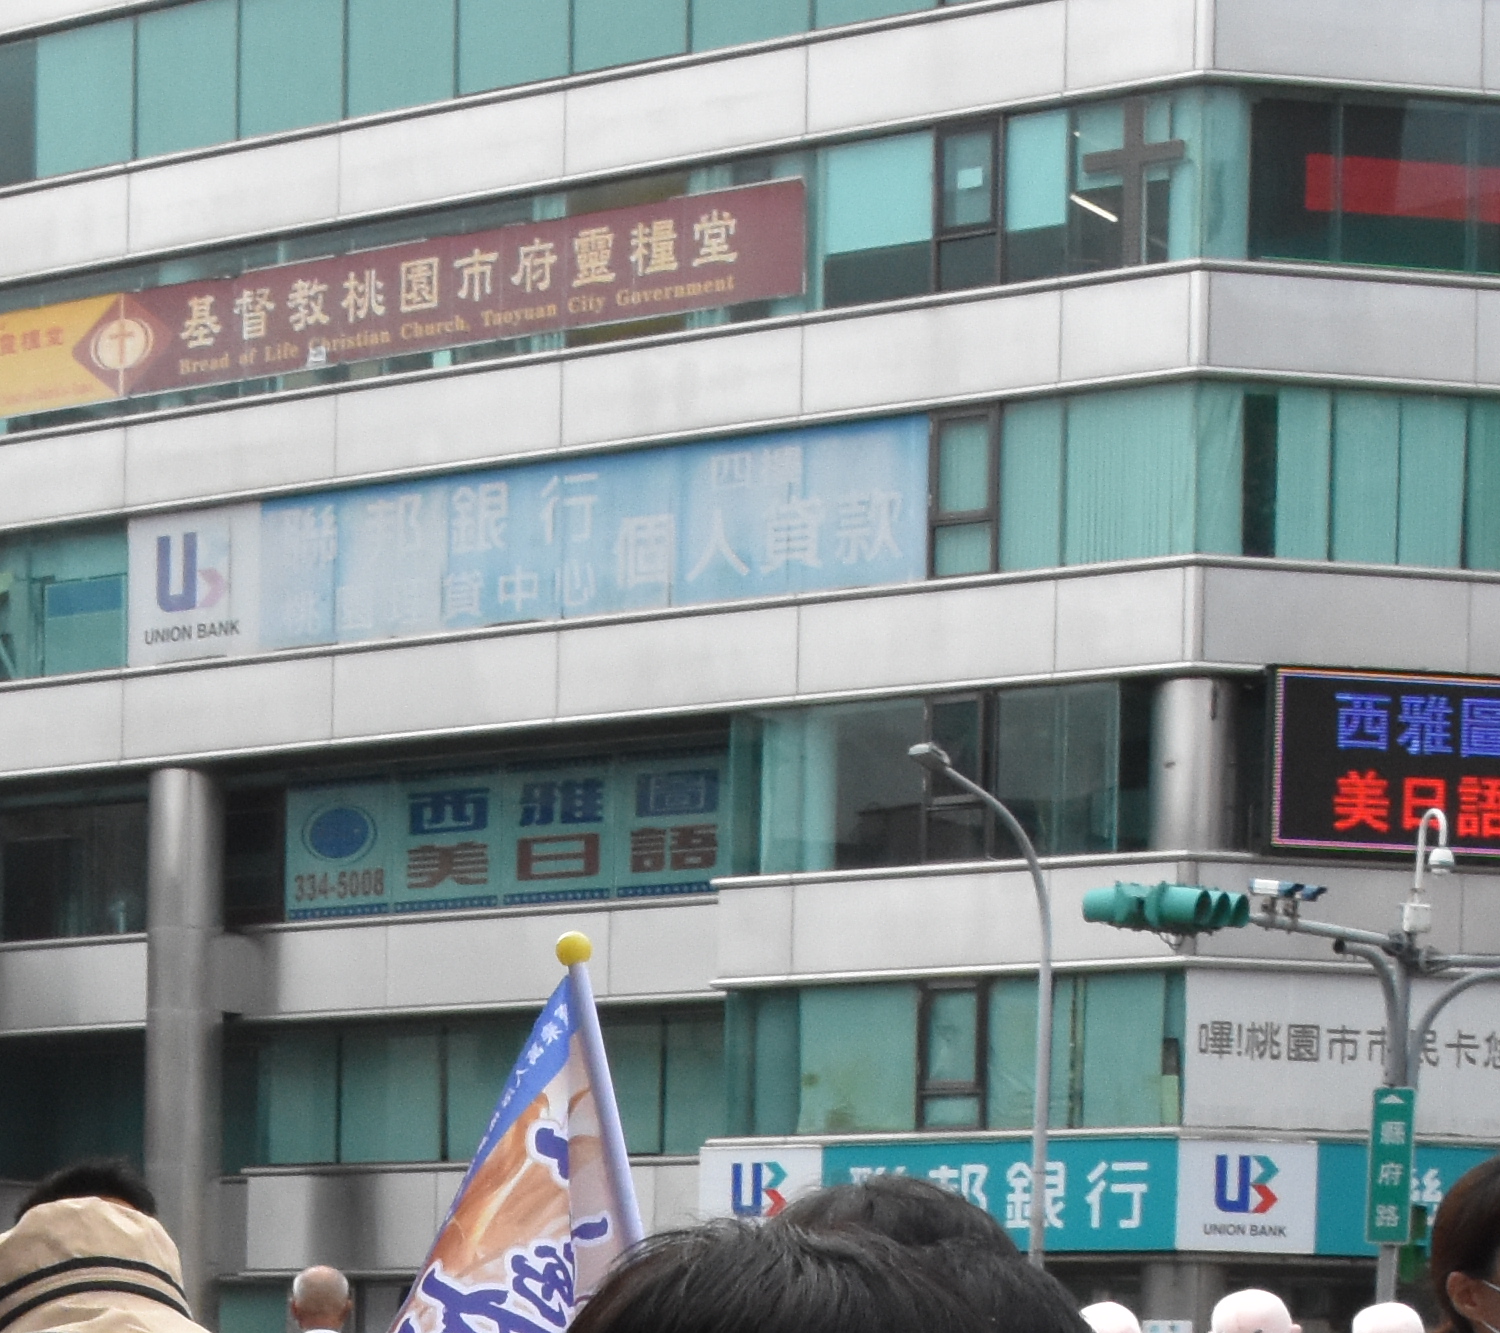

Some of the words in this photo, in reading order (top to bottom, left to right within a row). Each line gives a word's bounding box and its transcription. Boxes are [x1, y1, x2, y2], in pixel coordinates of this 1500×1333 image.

[179, 209, 739, 348] 基督教桃園市府靈糧堂
[179, 354, 229, 375] Bread
[239, 349, 257, 366] of
[265, 342, 298, 363] Life
[308, 328, 391, 356] Christian
[481, 303, 559, 334] Taoyuan
[567, 293, 607, 320] City
[616, 275, 737, 312] Government
[144, 624, 192, 645] UNION
[197, 619, 240, 641] BANK
[409, 769, 720, 835] 西雅圖
[407, 824, 718, 890] 美日語
[1204, 1223, 1245, 1239] UNION
[1249, 1223, 1287, 1239] BANK
